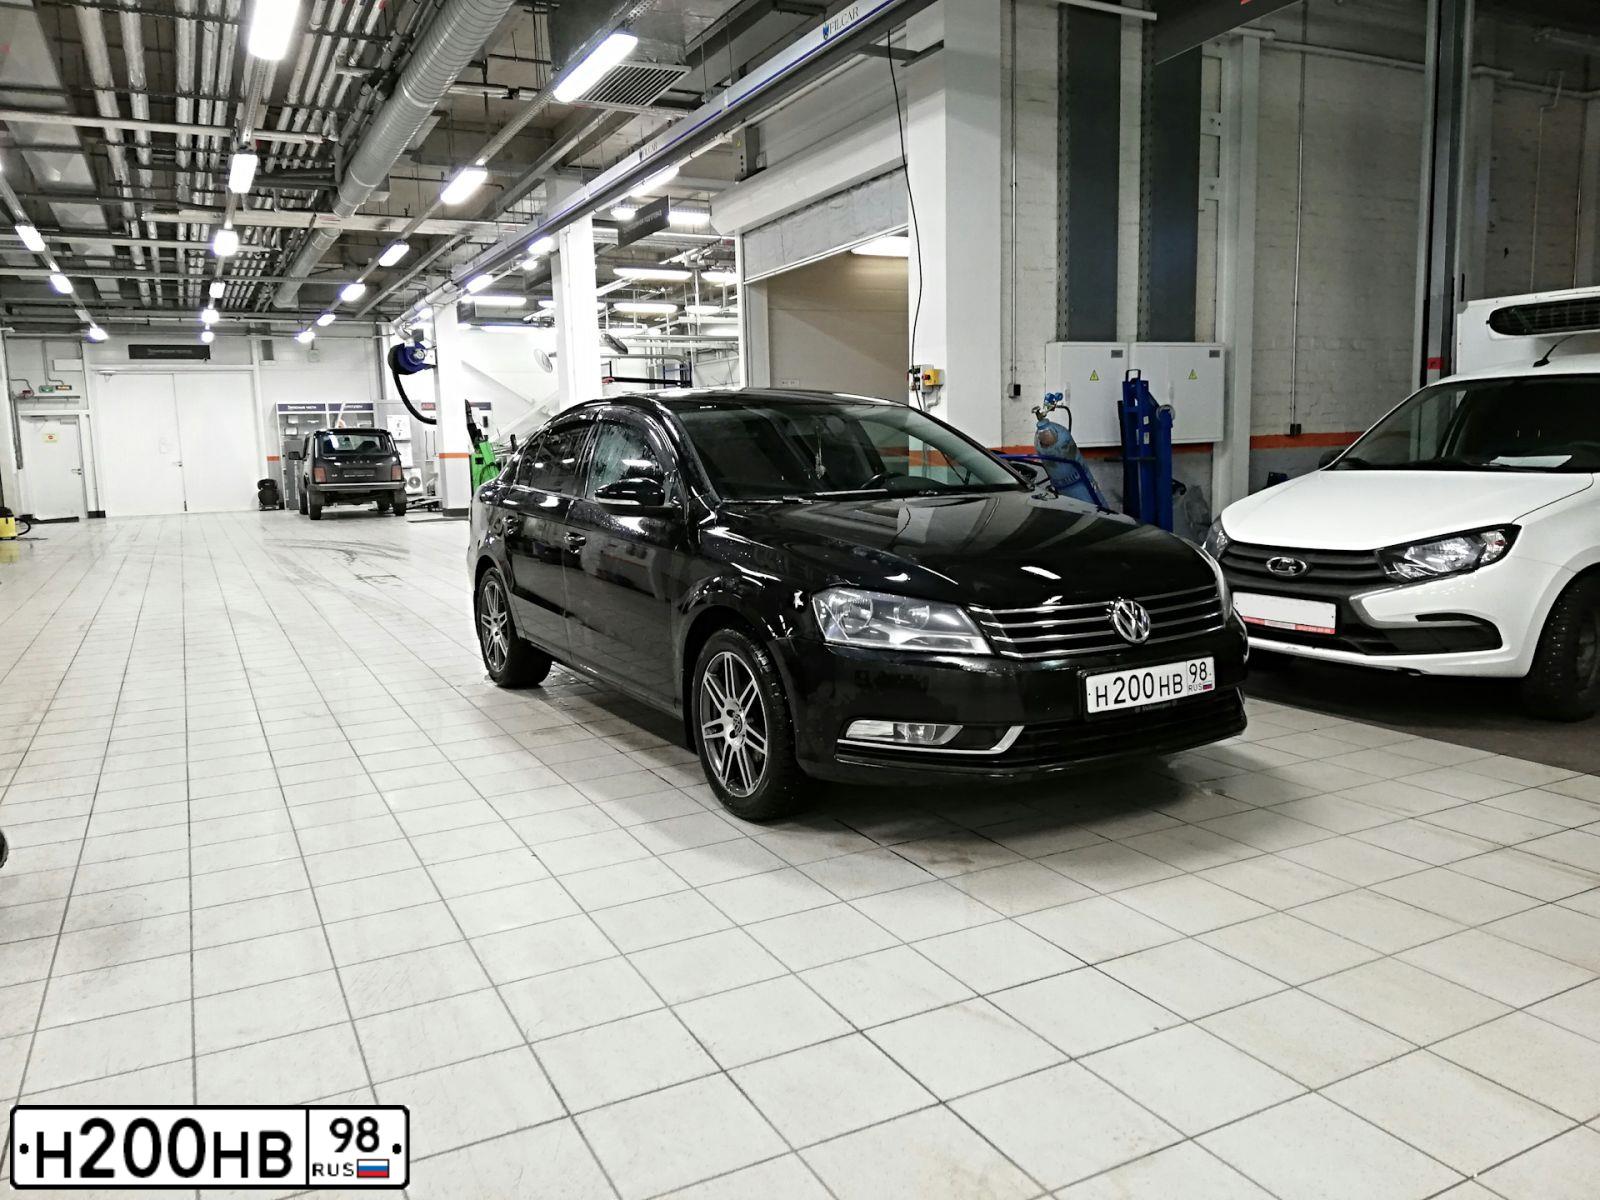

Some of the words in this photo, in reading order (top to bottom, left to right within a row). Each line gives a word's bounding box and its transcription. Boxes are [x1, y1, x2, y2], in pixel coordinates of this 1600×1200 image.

[828, 6, 860, 36] FILCAR
[1188, 661, 1208, 683] 98
[1188, 683, 1203, 692] RUS
